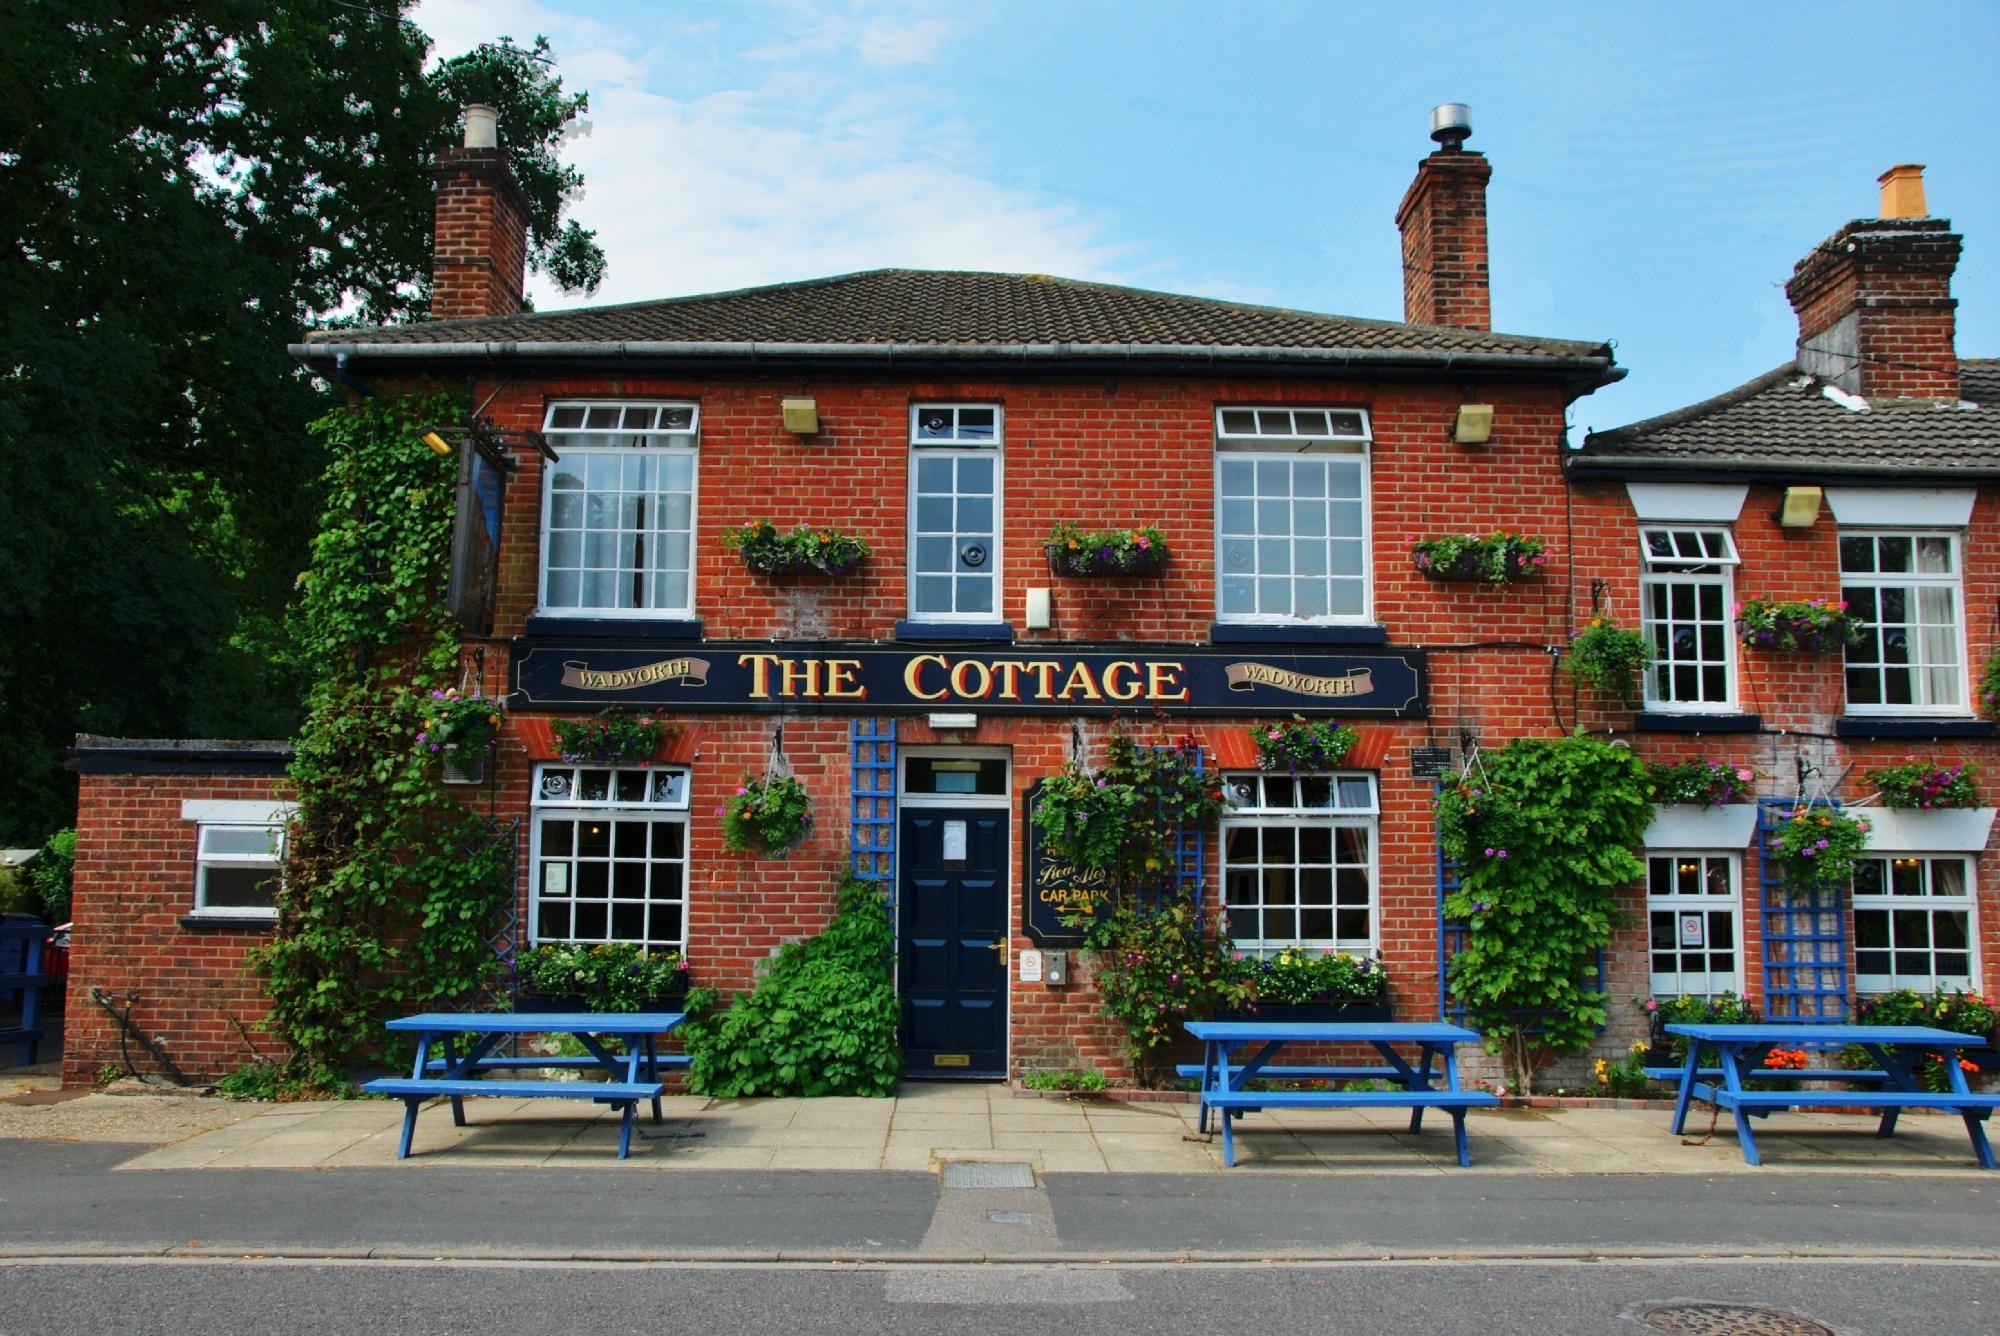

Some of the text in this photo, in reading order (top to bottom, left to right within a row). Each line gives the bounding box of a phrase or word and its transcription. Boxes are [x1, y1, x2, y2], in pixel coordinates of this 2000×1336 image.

[580, 660, 691, 688] WADWORTH
[738, 654, 1191, 702] THE COTTAGE
[1244, 665, 1355, 694] WADWORTH
[1040, 889, 1109, 902] CAR PARK
